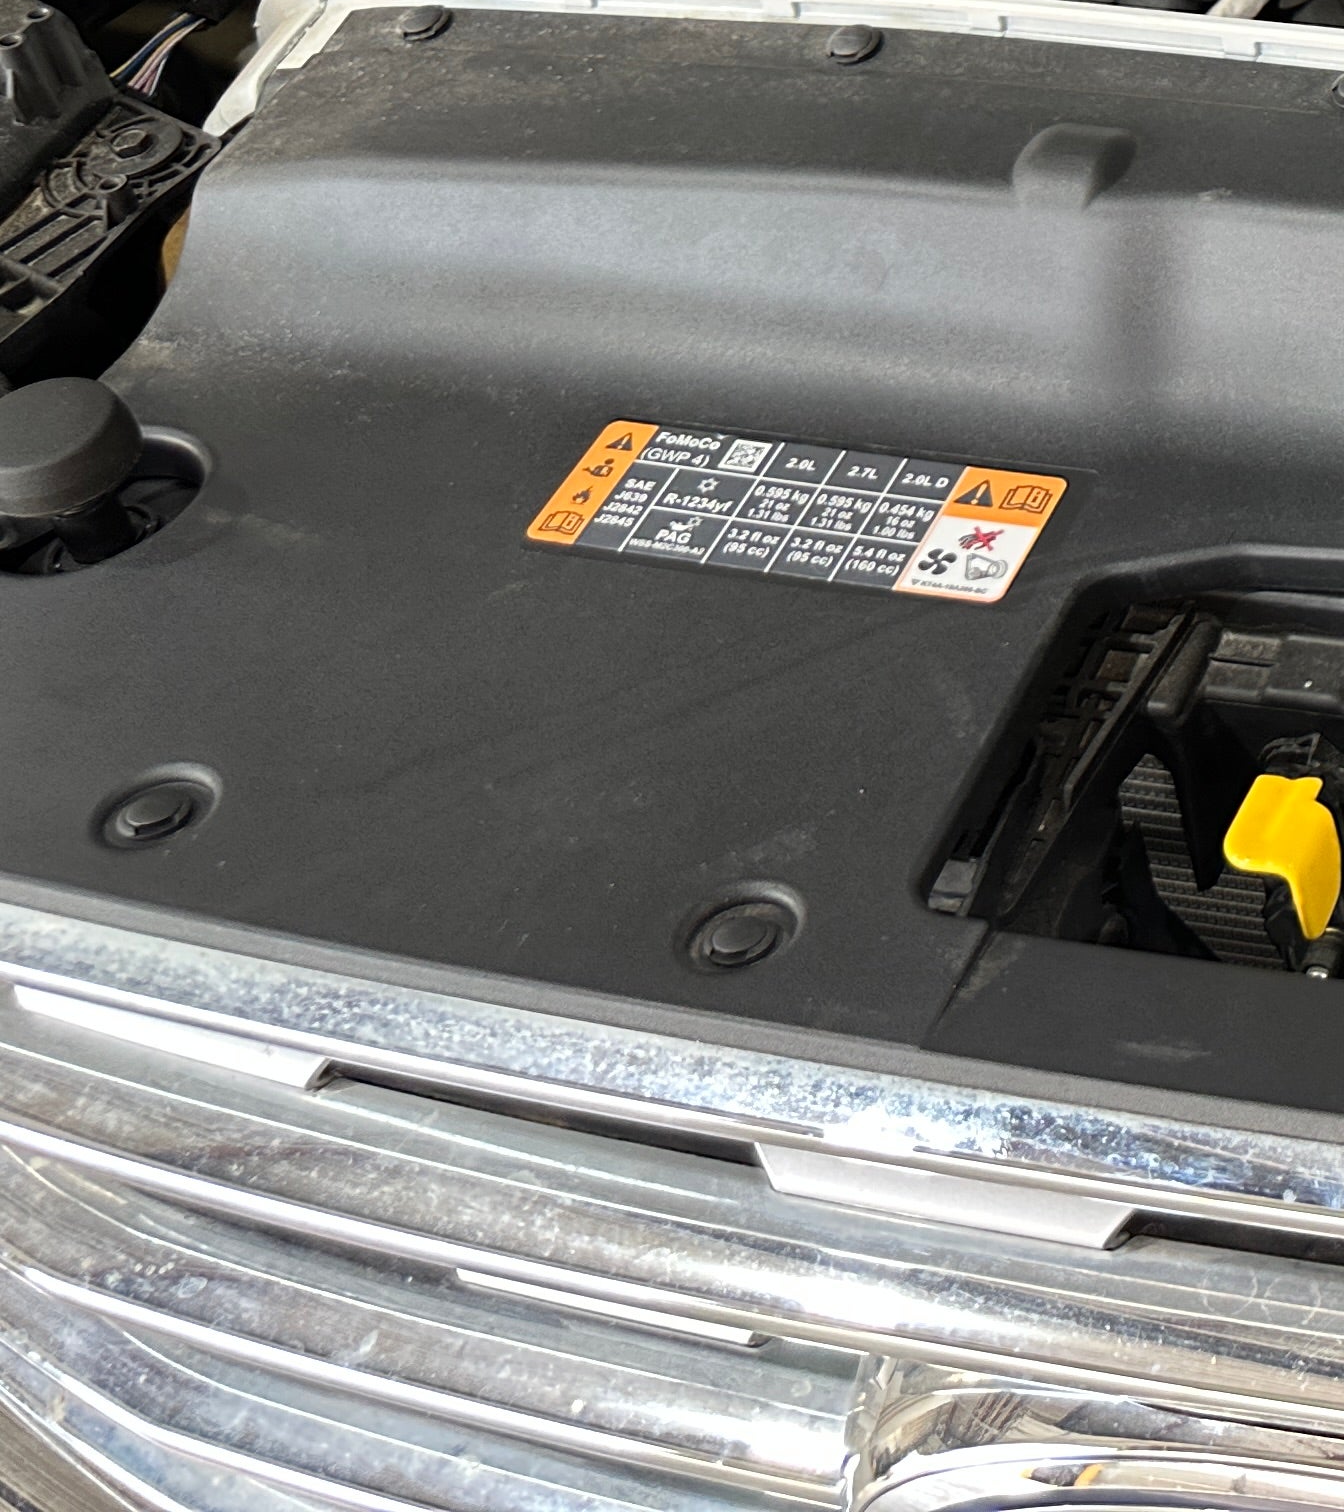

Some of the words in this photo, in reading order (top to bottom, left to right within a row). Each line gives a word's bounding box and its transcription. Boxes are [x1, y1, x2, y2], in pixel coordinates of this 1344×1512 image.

[656, 432, 721, 450] FoMoCo
[641, 448, 690, 463] (GWP
[692, 455, 710, 468] 4)
[786, 458, 816, 471] 2.0L
[848, 466, 879, 479] 2.7L
[625, 479, 657, 491] SAE
[902, 474, 932, 487] 2.0L
[936, 478, 949, 488] D
[614, 491, 648, 503] J639
[755, 485, 790, 499] 0.595
[792, 490, 810, 505] kg
[664, 493, 735, 514] R-1234yf
[759, 499, 774, 509] 21
[776, 502, 790, 511] oz
[817, 494, 853, 508] 0.595
[855, 499, 873, 514] kg
[748, 508, 769, 519] 1.31
[772, 512, 790, 523] lbs
[822, 508, 836, 517] 21
[838, 511, 853, 520] oz
[879, 502, 915, 517] 0.454
[917, 507, 935, 523] kg
[811, 517, 831, 528] 1.31
[834, 520, 852, 531] lbs
[886, 517, 899, 526] 16
[901, 520, 915, 528] oz
[655, 529, 692, 544] PAG
[729, 529, 749, 540] 3.2
[751, 532, 763, 542] fl
[764, 535, 781, 545] oz
[873, 526, 896, 537] 1.00
[897, 529, 915, 540] lbs
[724, 542, 748, 554] (95
[749, 546, 770, 558] cc)
[791, 537, 812, 549] 3.2
[814, 541, 825, 551] fl
[827, 544, 844, 554] oz
[787, 550, 810, 564] (95
[811, 554, 834, 568] cc)
[853, 546, 874, 558] 5.4
[876, 549, 888, 559] fl
[889, 552, 906, 562] oz
[845, 558, 875, 573] (160
[880, 563, 900, 577] cc)
